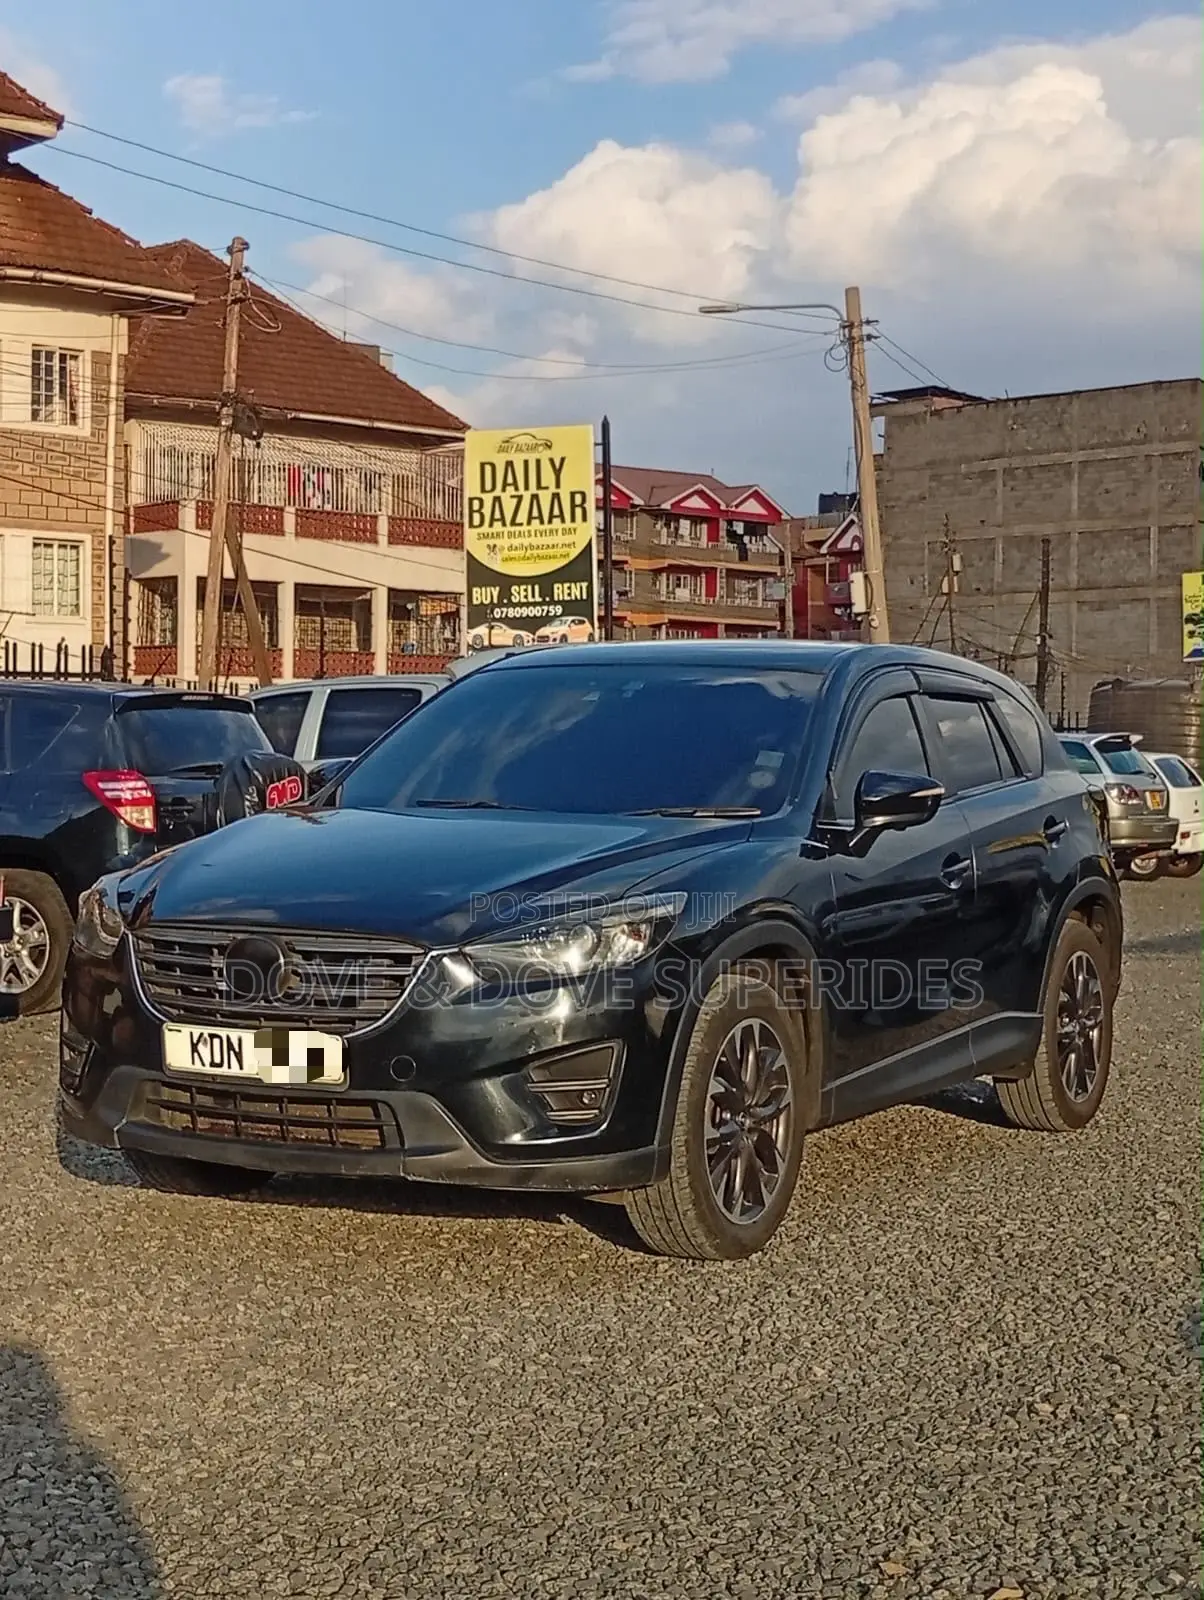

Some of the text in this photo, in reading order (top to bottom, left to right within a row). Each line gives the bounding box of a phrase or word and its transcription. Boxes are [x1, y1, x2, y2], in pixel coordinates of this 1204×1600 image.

[479, 456, 566, 494] DAILY
[468, 490, 588, 529] BAZAAR
[477, 527, 578, 541] SMART DEALS EVERY DAY
[507, 541, 577, 555] dailybazaar.net
[472, 586, 500, 605] BUY
[510, 584, 542, 603] SELL
[553, 582, 589, 601] RENT
[493, 605, 563, 618] 0780900759
[189, 1031, 244, 1071] KDN
